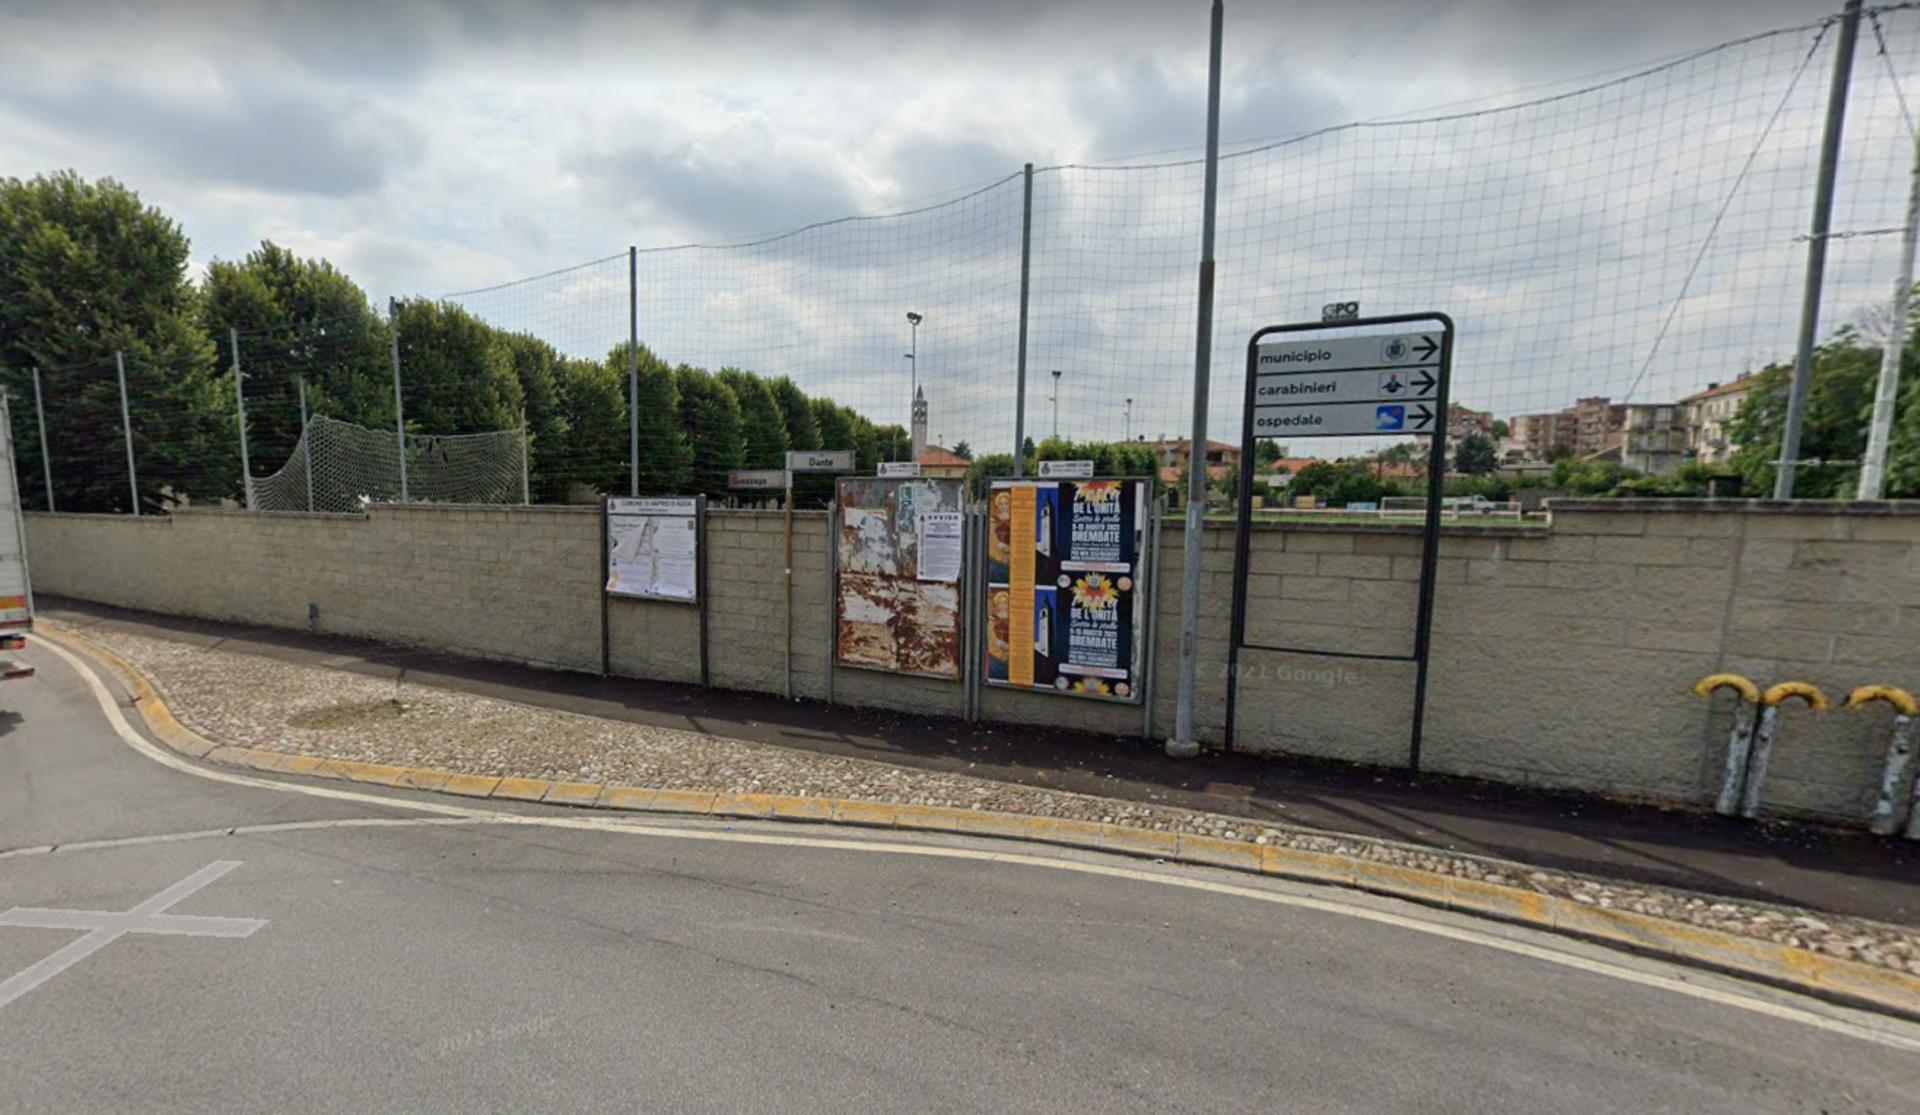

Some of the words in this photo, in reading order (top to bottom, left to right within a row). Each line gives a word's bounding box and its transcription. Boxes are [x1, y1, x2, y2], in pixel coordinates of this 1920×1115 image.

[1322, 301, 1359, 315] GPO
[1260, 349, 1332, 365] municipio
[1258, 381, 1336, 396] carabinieri
[1257, 414, 1323, 428] ospedale
[808, 458, 834, 467] Dante
[1071, 531, 1120, 543] BREMBATE
[1069, 635, 1118, 649] BREMBATE
